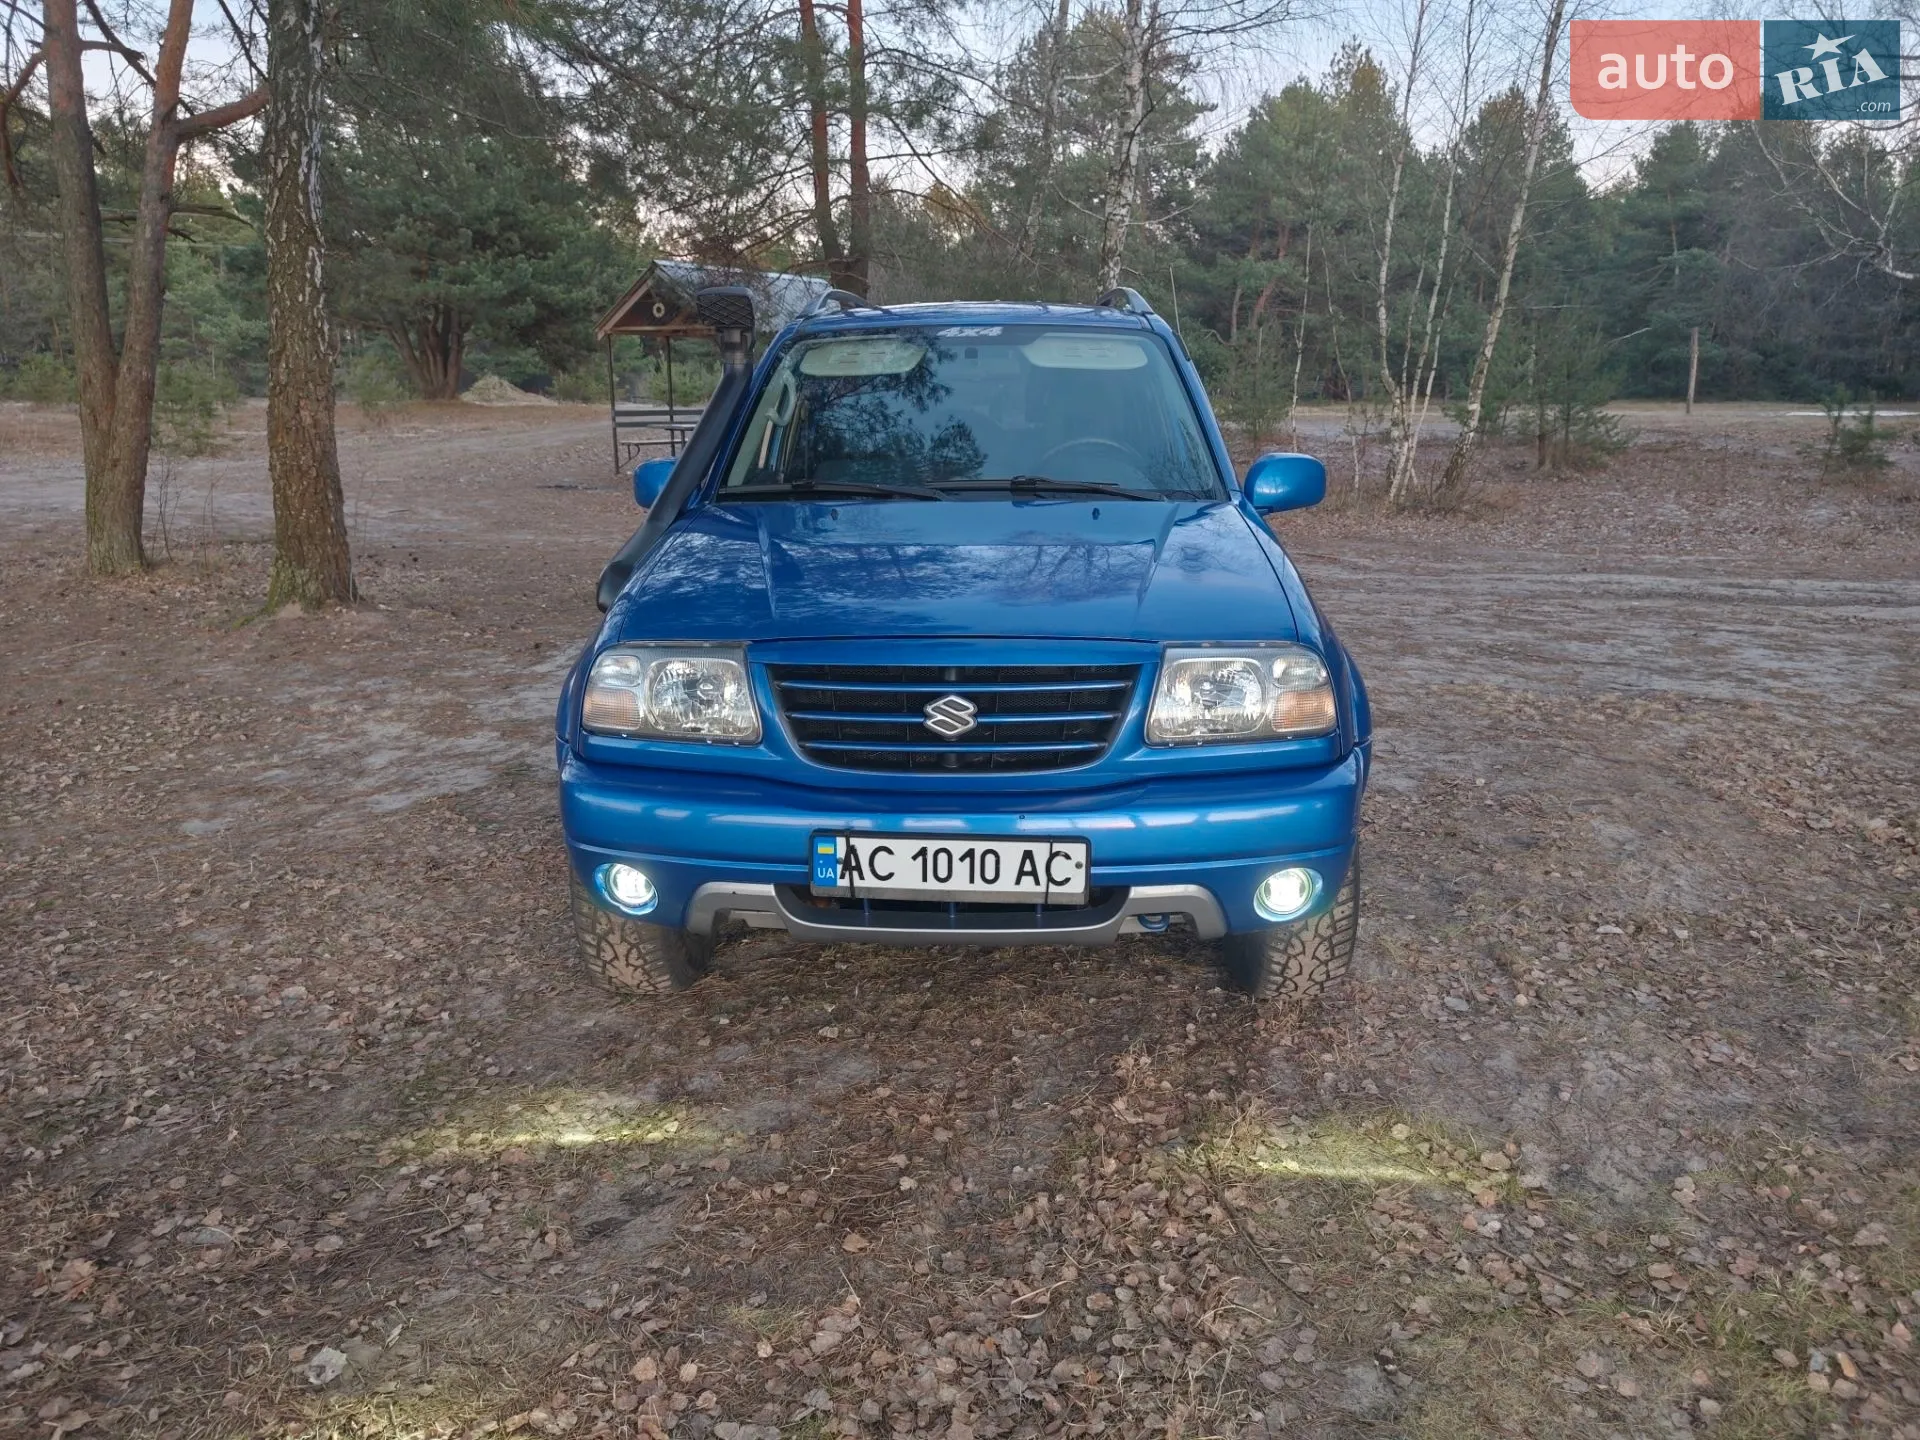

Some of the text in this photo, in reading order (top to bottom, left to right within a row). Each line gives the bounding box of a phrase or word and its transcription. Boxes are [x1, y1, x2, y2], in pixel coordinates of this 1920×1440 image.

[817, 867, 834, 879] UA
[839, 845, 1073, 887] AC 1010 AC
